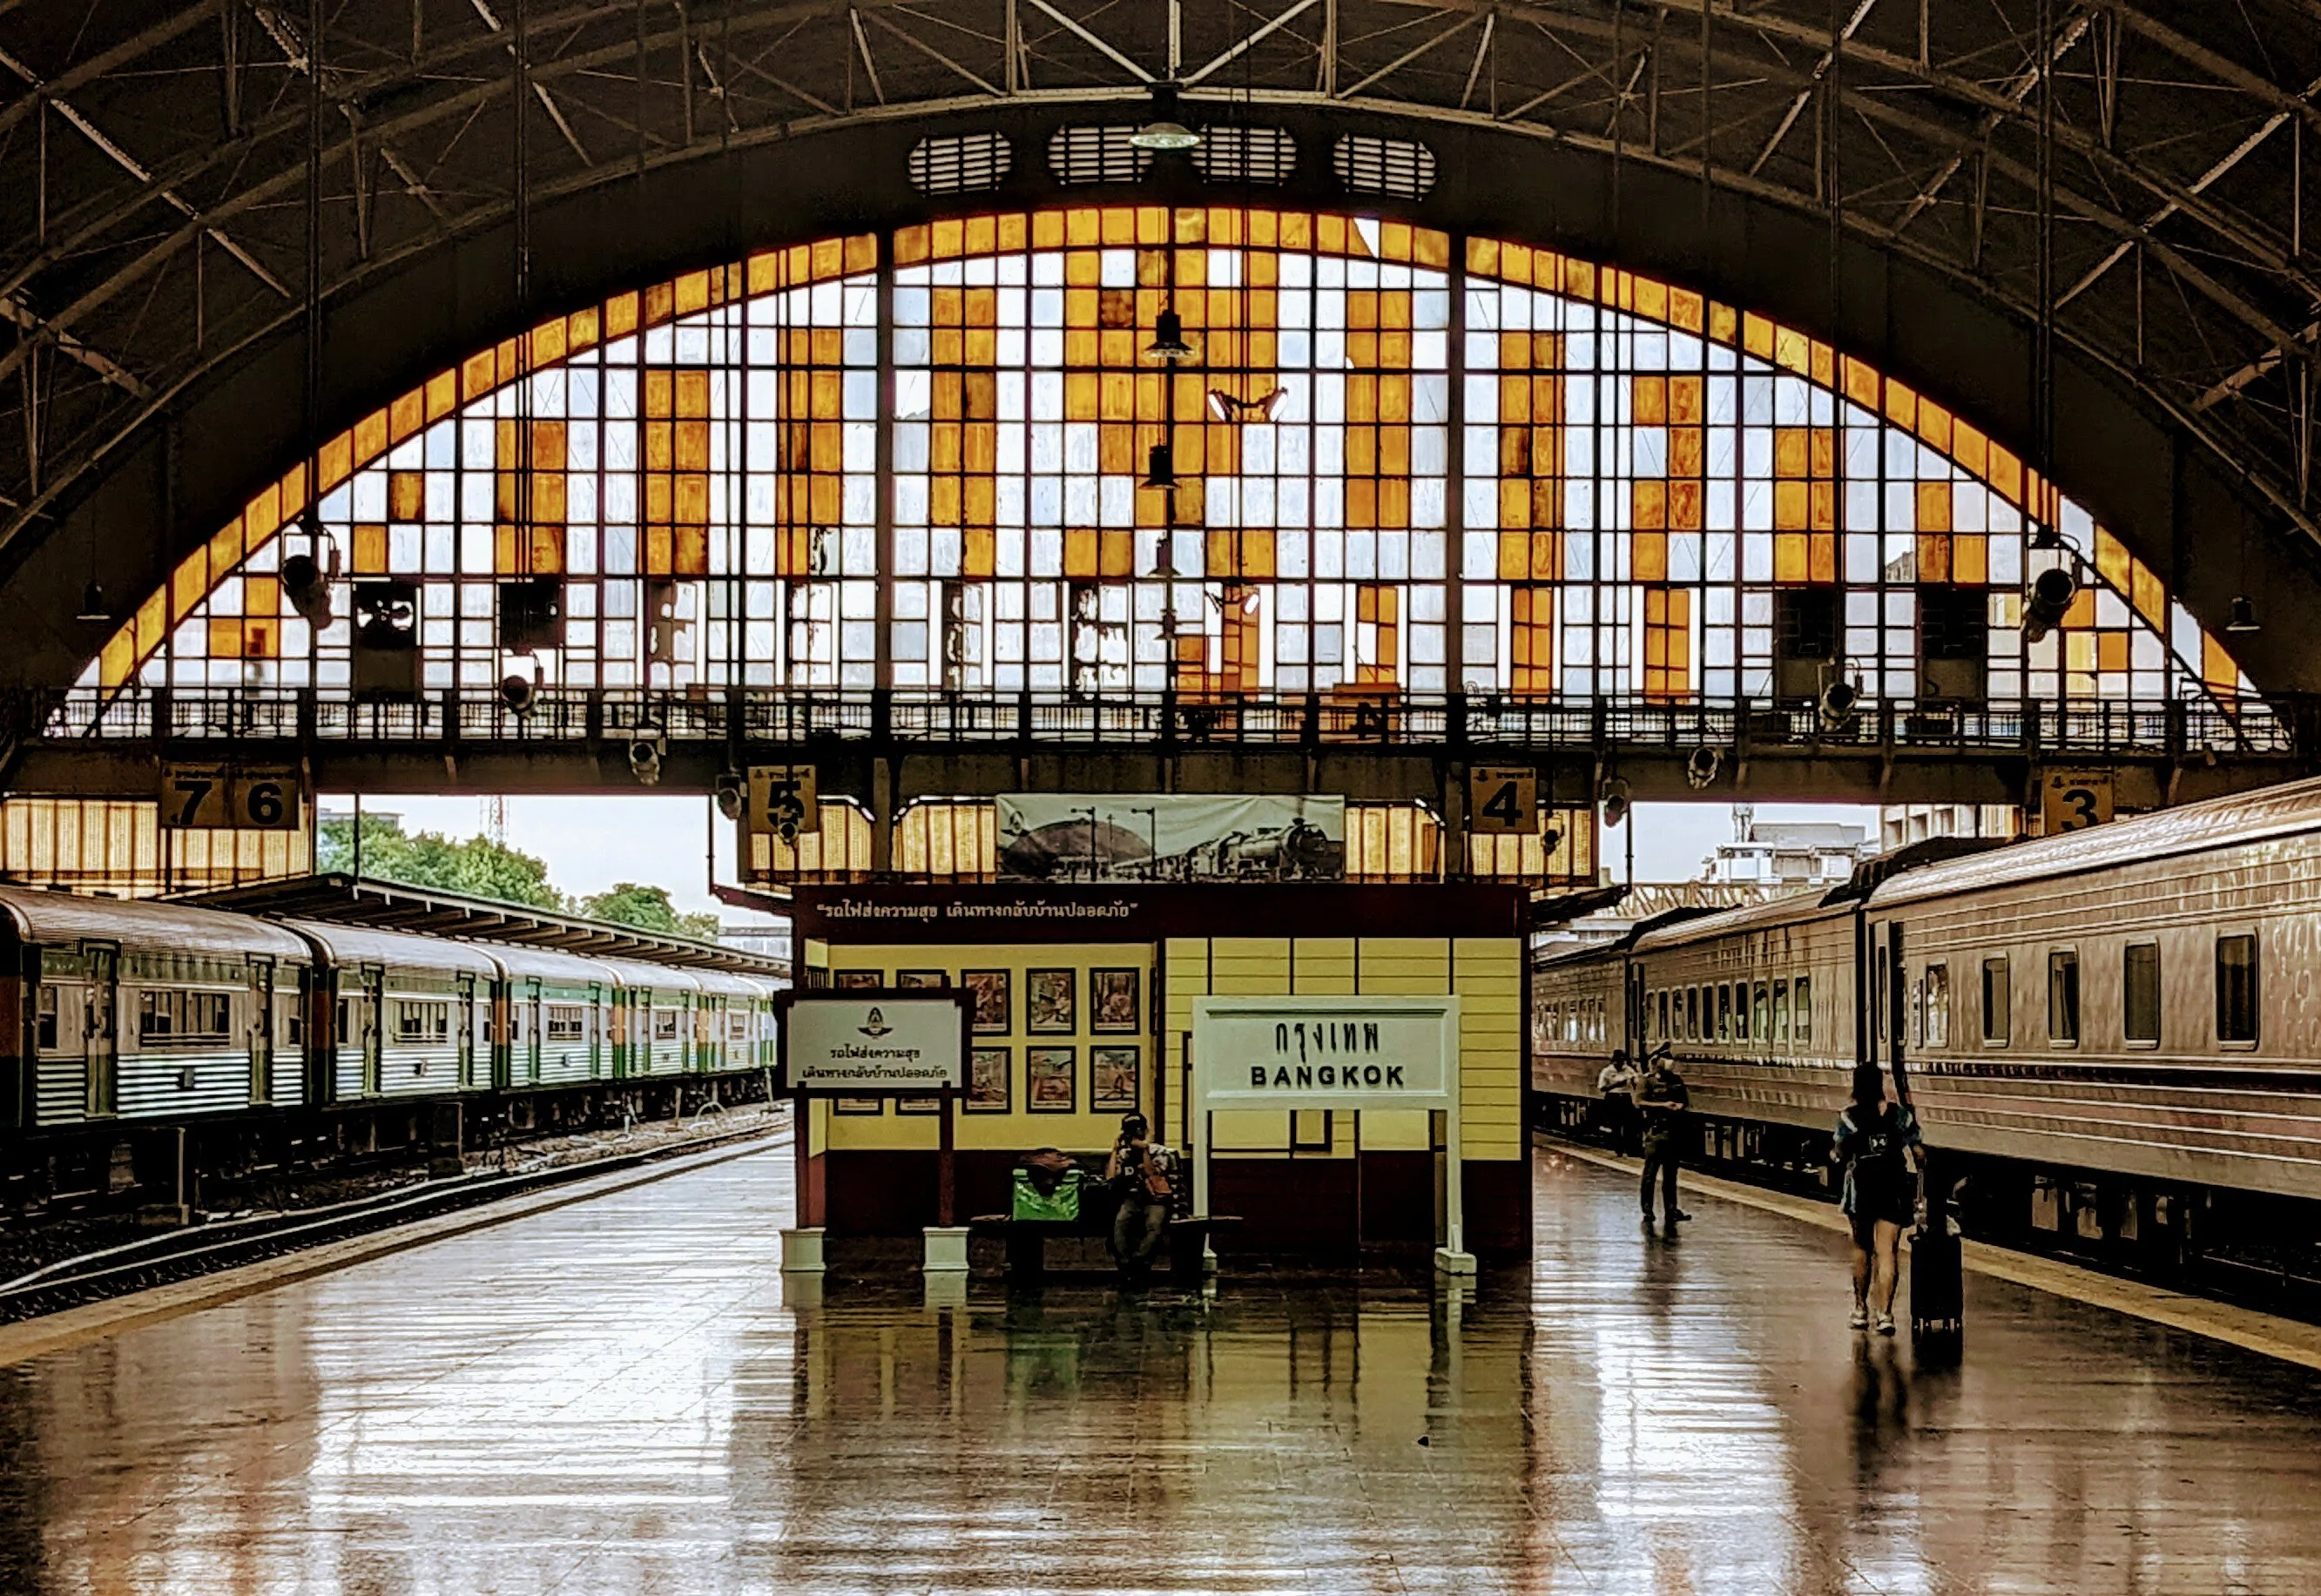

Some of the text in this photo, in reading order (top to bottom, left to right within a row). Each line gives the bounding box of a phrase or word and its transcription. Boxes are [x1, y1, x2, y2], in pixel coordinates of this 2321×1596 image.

[175, 780, 213, 825] 7
[247, 782, 283, 825] 6
[766, 780, 805, 828] 5
[1482, 781, 1523, 827] 4
[2061, 789, 2099, 832] 3
[830, 1044, 920, 1062] รถไฟส่งความสุข
[1276, 1022, 1379, 1064] กรุงเทพ
[1251, 1065, 1404, 1088] BANGKOK
